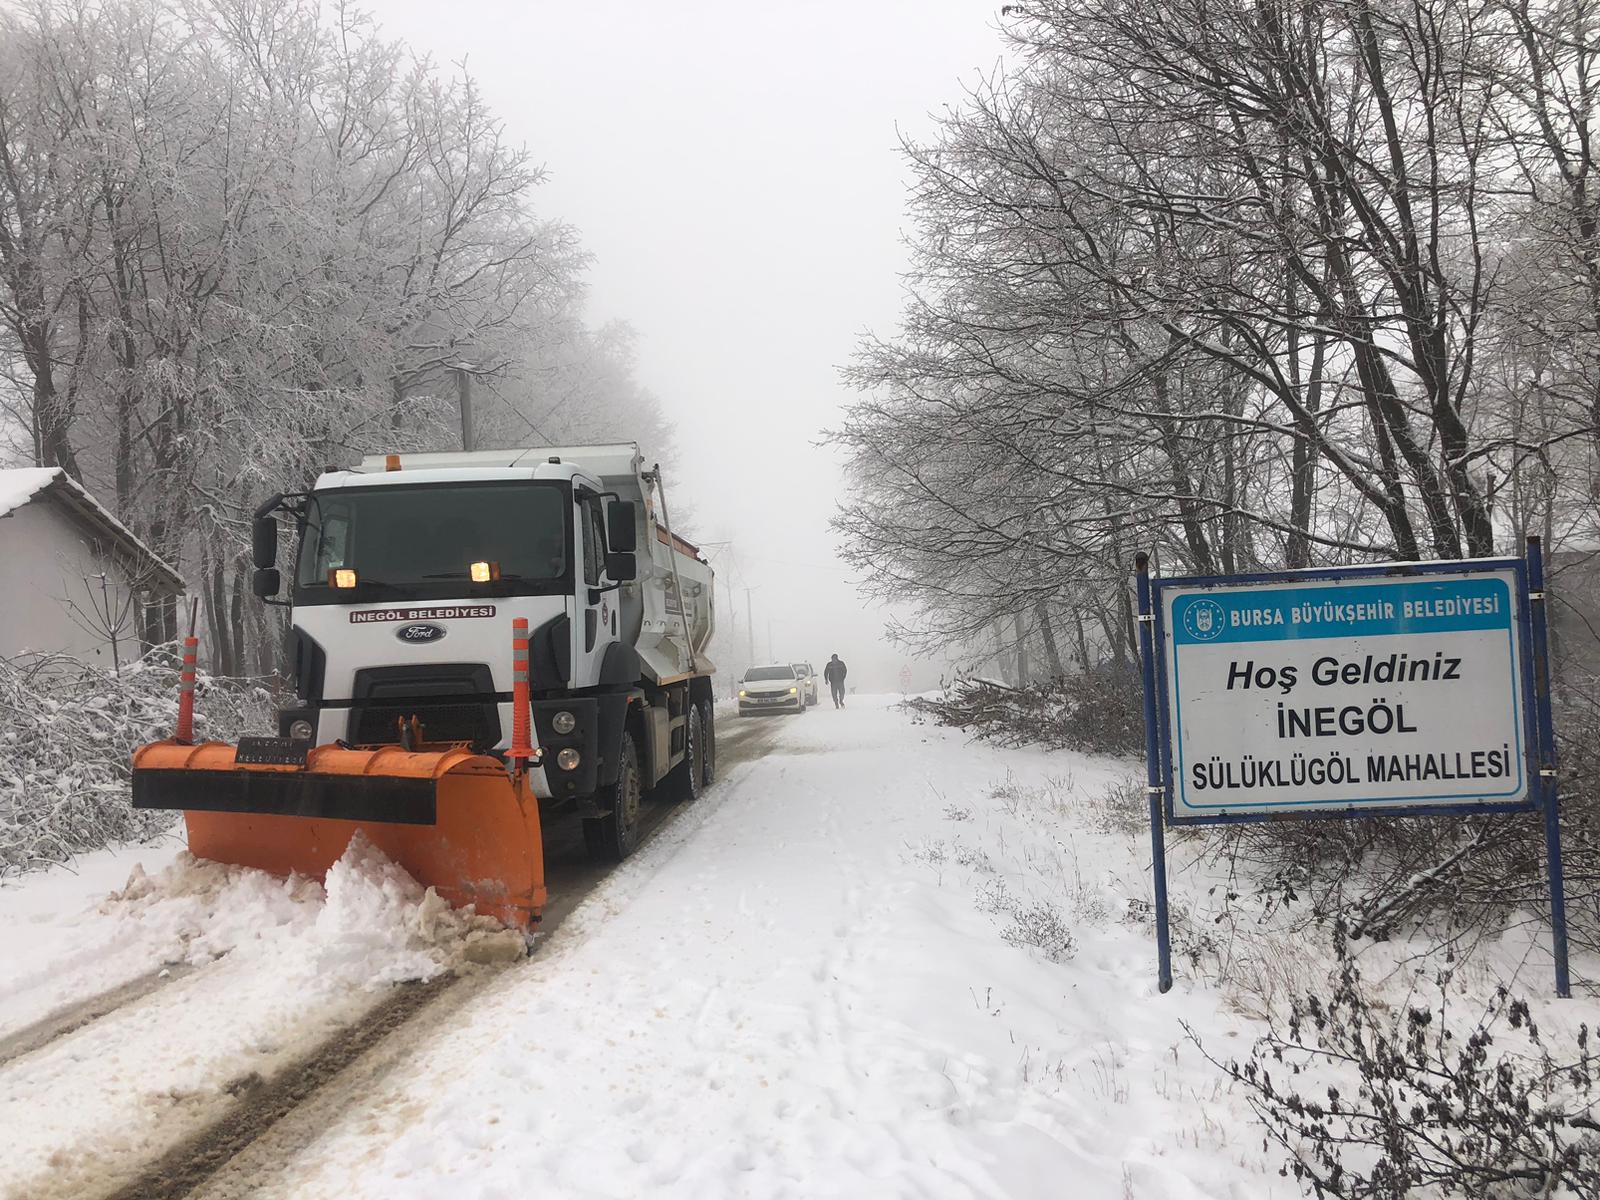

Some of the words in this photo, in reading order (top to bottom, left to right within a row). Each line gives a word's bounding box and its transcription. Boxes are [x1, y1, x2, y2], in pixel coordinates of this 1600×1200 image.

[352, 610, 405, 623] İNEGÖL
[408, 606, 493, 620] BELEDİYESİ
[1230, 608, 1285, 627] BURSA
[1291, 599, 1395, 625] BÜYÜKŞEHİR
[1403, 593, 1499, 618] BELEDİYESİ
[405, 626, 433, 639] Ford
[1226, 660, 1298, 694] Hoş
[1311, 652, 1462, 686] Geldiniz
[1277, 698, 1418, 739] İNEGÖL
[1192, 751, 1361, 790] SÜLÜKLÜGÖL
[1367, 743, 1511, 783] MAHALLESİ
